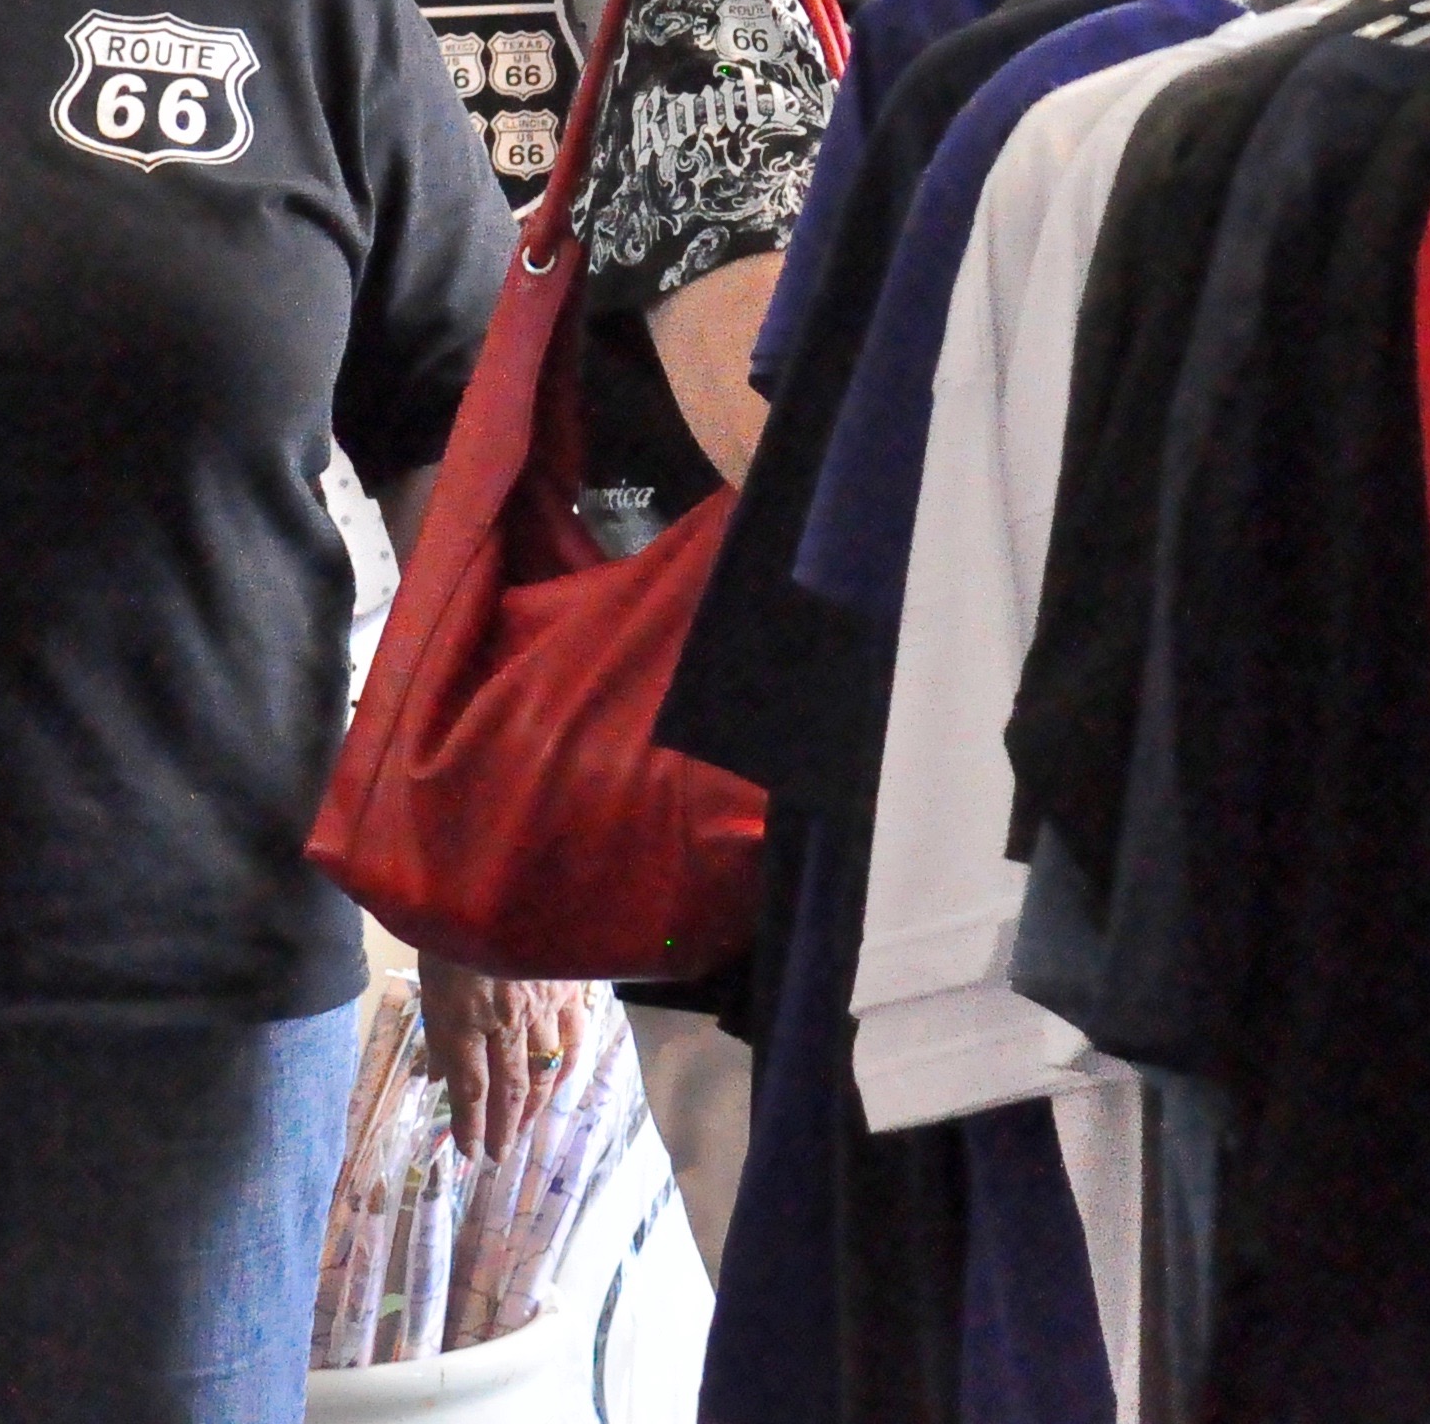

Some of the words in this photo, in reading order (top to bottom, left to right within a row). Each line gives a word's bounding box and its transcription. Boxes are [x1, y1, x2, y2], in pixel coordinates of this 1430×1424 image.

[501, 40, 544, 51] TEXAS
[732, 27, 769, 53] 66
[107, 35, 216, 70] ROUTE
[513, 54, 532, 63] US
[505, 65, 542, 87] 66
[96, 73, 210, 145] 66
[516, 133, 535, 142] US
[508, 144, 544, 165] 66
